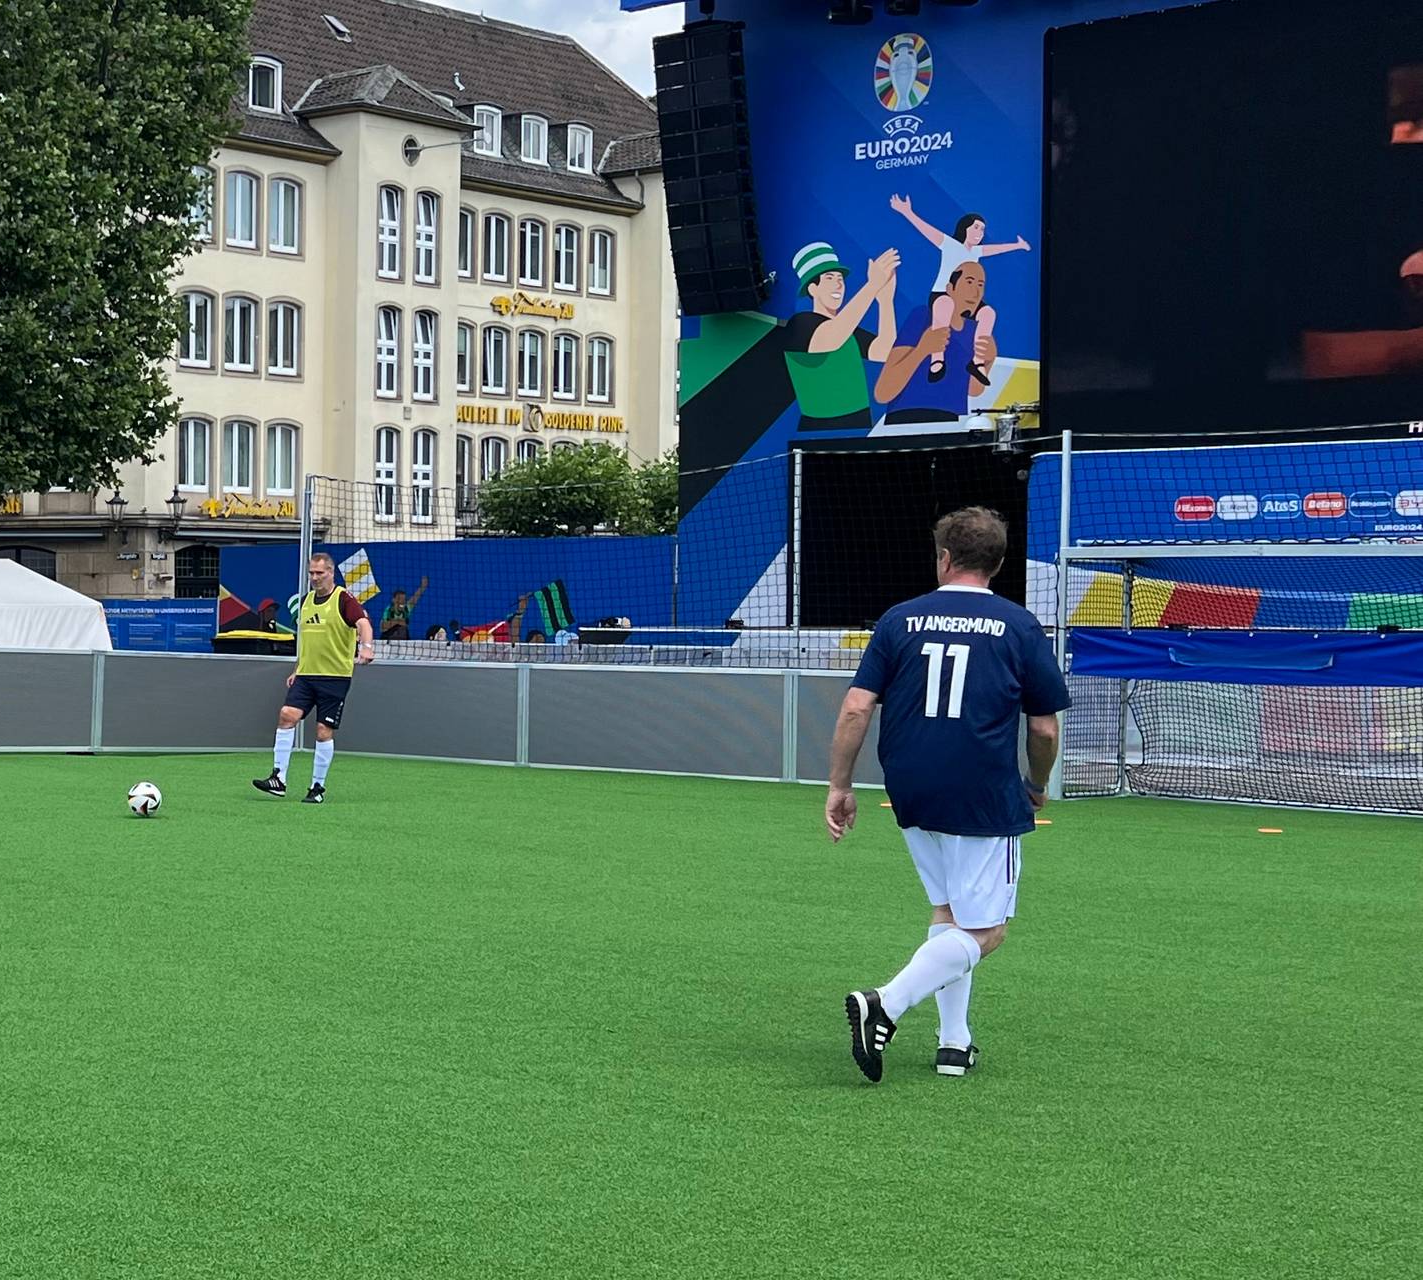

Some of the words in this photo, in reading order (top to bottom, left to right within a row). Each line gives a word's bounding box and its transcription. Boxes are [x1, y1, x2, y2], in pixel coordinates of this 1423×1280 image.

[884, 118, 919, 134] UEFA
[855, 131, 953, 160] EURO2024
[875, 154, 929, 170] GERMANY
[598, 415, 626, 433] RING
[905, 616, 925, 633] TV
[923, 615, 1006, 637] ANGERMUND
[921, 642, 970, 719] 11
